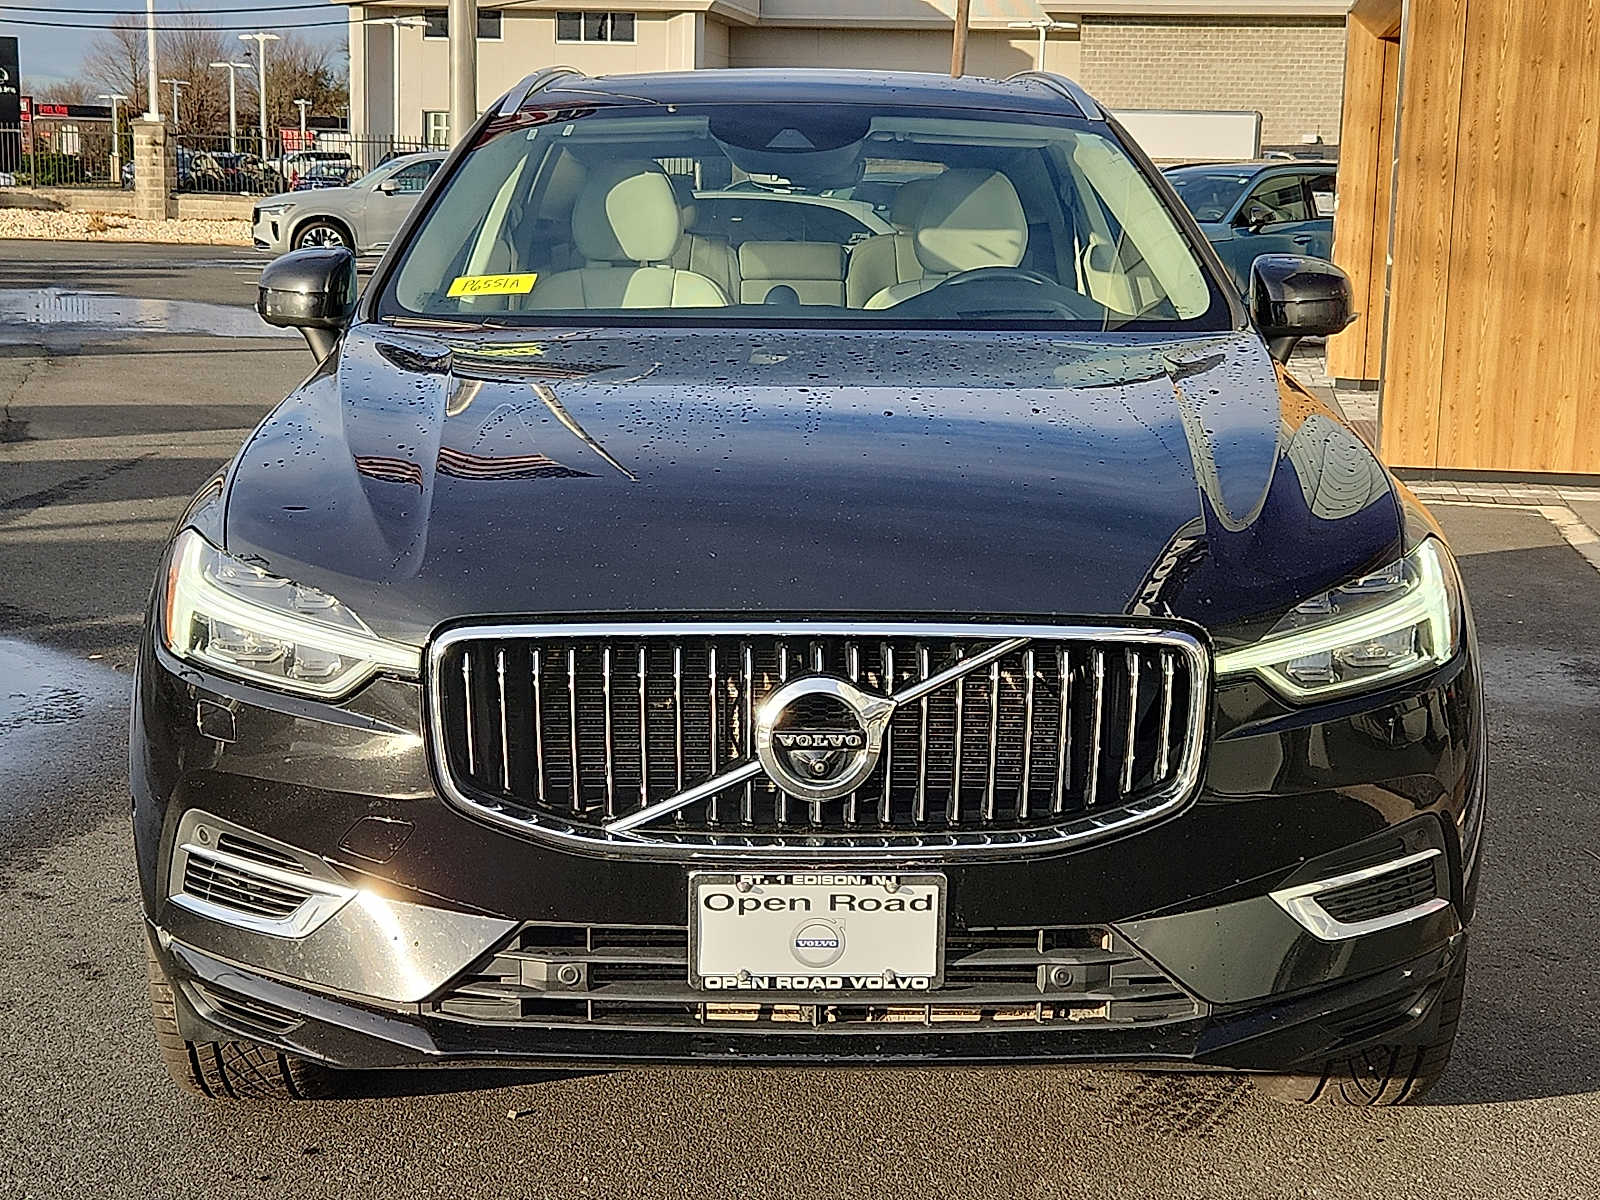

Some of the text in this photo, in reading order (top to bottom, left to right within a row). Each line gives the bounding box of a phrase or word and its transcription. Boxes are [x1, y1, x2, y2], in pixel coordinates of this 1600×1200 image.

[775, 734, 862, 747] VOLVO
[740, 875, 897, 885] RT. 1 EDISON, NJ
[703, 893, 933, 915] Open Road
[704, 976, 929, 990] OPEN ROAD VOLVO
